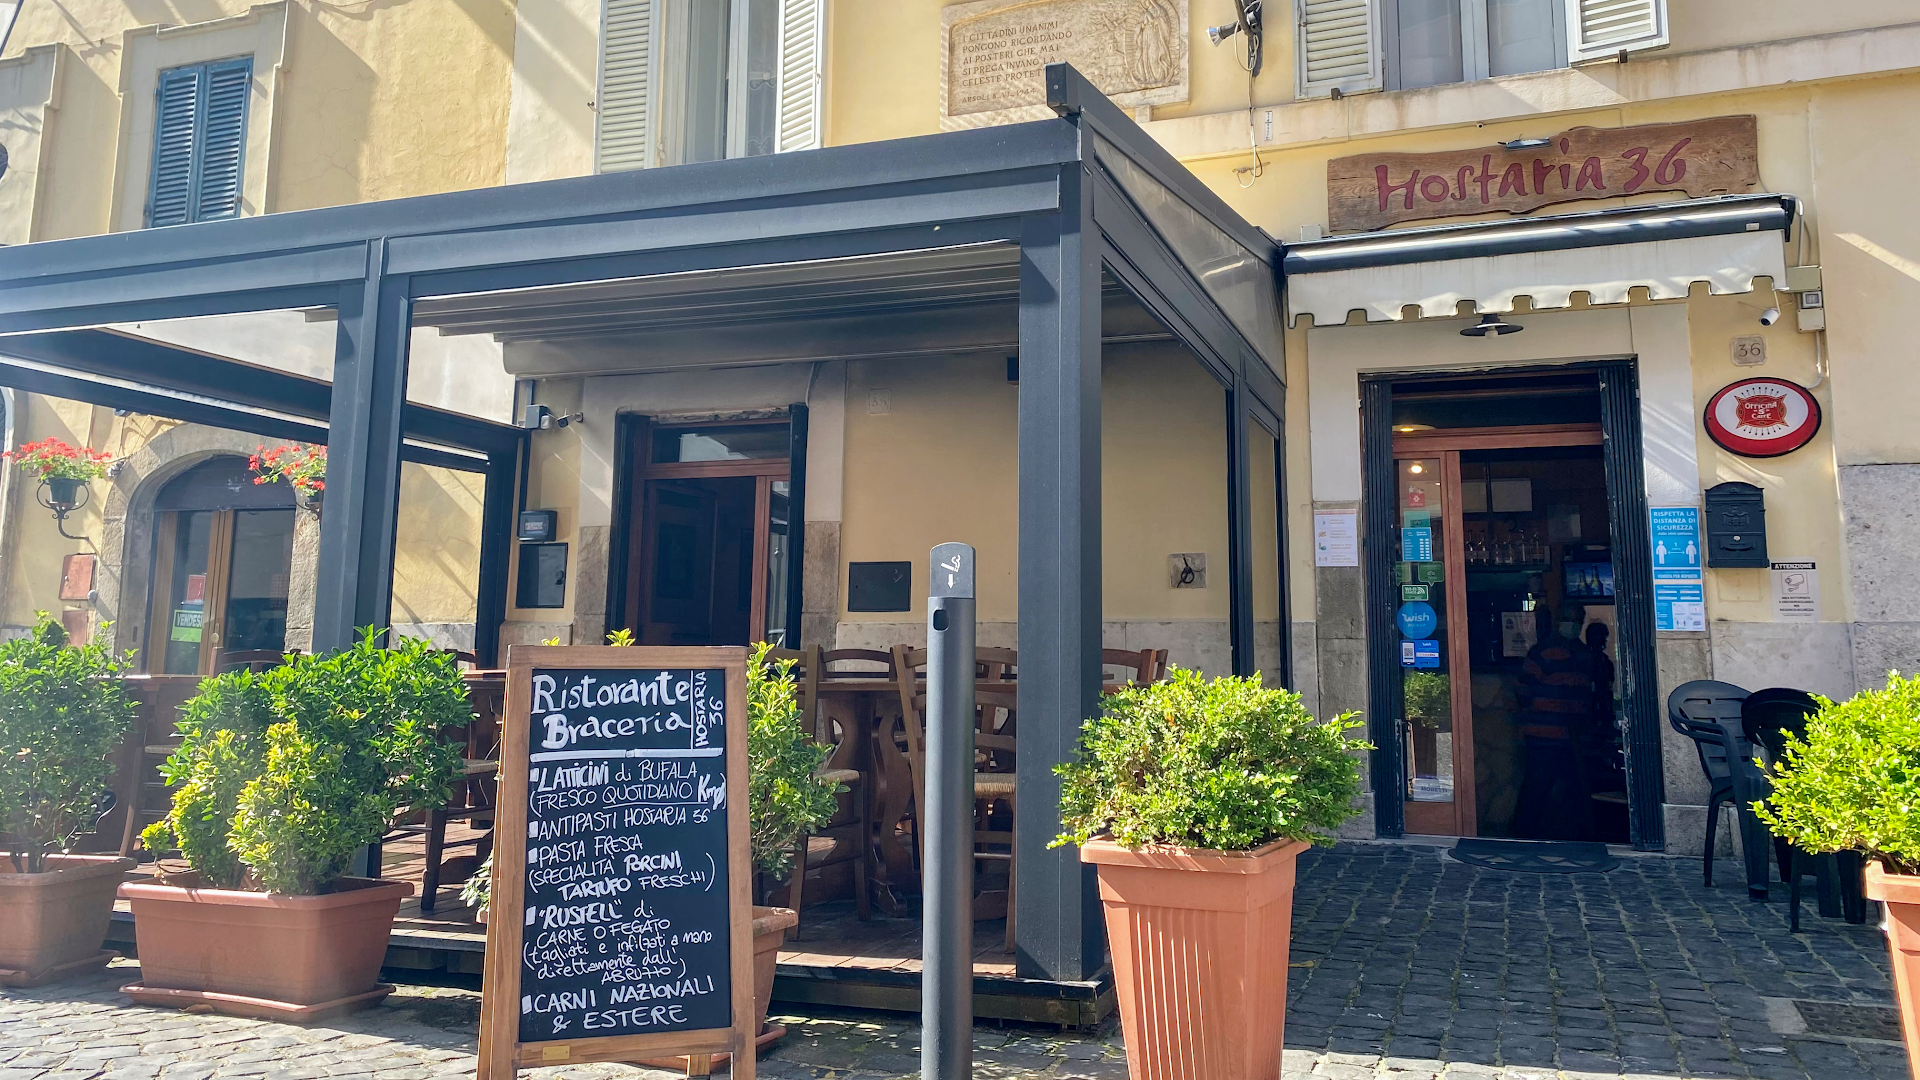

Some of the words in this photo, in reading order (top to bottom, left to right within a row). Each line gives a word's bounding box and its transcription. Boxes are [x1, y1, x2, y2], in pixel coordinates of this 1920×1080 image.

[962, 40, 1007, 54] PONGONO
[1011, 30, 1073, 47] RICORDANDO
[969, 27, 1017, 41] CITTADINI
[1019, 21, 1059, 34] UNANIMI
[962, 68, 971, 76] SI
[973, 63, 1004, 75] PREGA
[1006, 58, 1040, 70] INVANO
[1043, 56, 1056, 65] LA
[963, 56, 972, 65] AI
[975, 50, 1013, 63] POSTERI
[1016, 47, 1036, 57] CHE
[1040, 44, 1060, 53] MAI
[962, 75, 1002, 87] CELESTE
[1005, 67, 1046, 81] PROTET
[1374, 136, 1607, 213] Hostaria
[1621, 136, 1693, 194] 36
[1738, 342, 1761, 357] 36
[1401, 611, 1430, 623] wish
[531, 671, 692, 714] Ristorante
[694, 671, 710, 748] HOSTARIA
[709, 696, 724, 728] 36
[541, 711, 692, 749] Braceria
[614, 762, 633, 782] di
[637, 761, 698, 782] BUFALA
[602, 781, 693, 805] QUOTIDIANO
[538, 811, 617, 841] ANTIPASTI
[623, 806, 687, 828] HOSTARIA
[692, 808, 711, 824] 36
[538, 840, 586, 869] PASTA
[594, 833, 644, 857] FRESCA
[557, 877, 632, 901] TARTUFO
[633, 899, 655, 918] di
[536, 927, 587, 949] CARNE
[593, 926, 607, 939] O
[608, 918, 671, 937] FEGATO
[598, 942, 608, 954] e
[670, 935, 679, 946] a
[682, 930, 713, 944] mano
[537, 951, 637, 980] direttamente
[533, 988, 597, 1014] CARNI
[609, 975, 715, 1005] NAZIONALI
[552, 1014, 572, 1034] &
[583, 1004, 688, 1030] ESTERE
